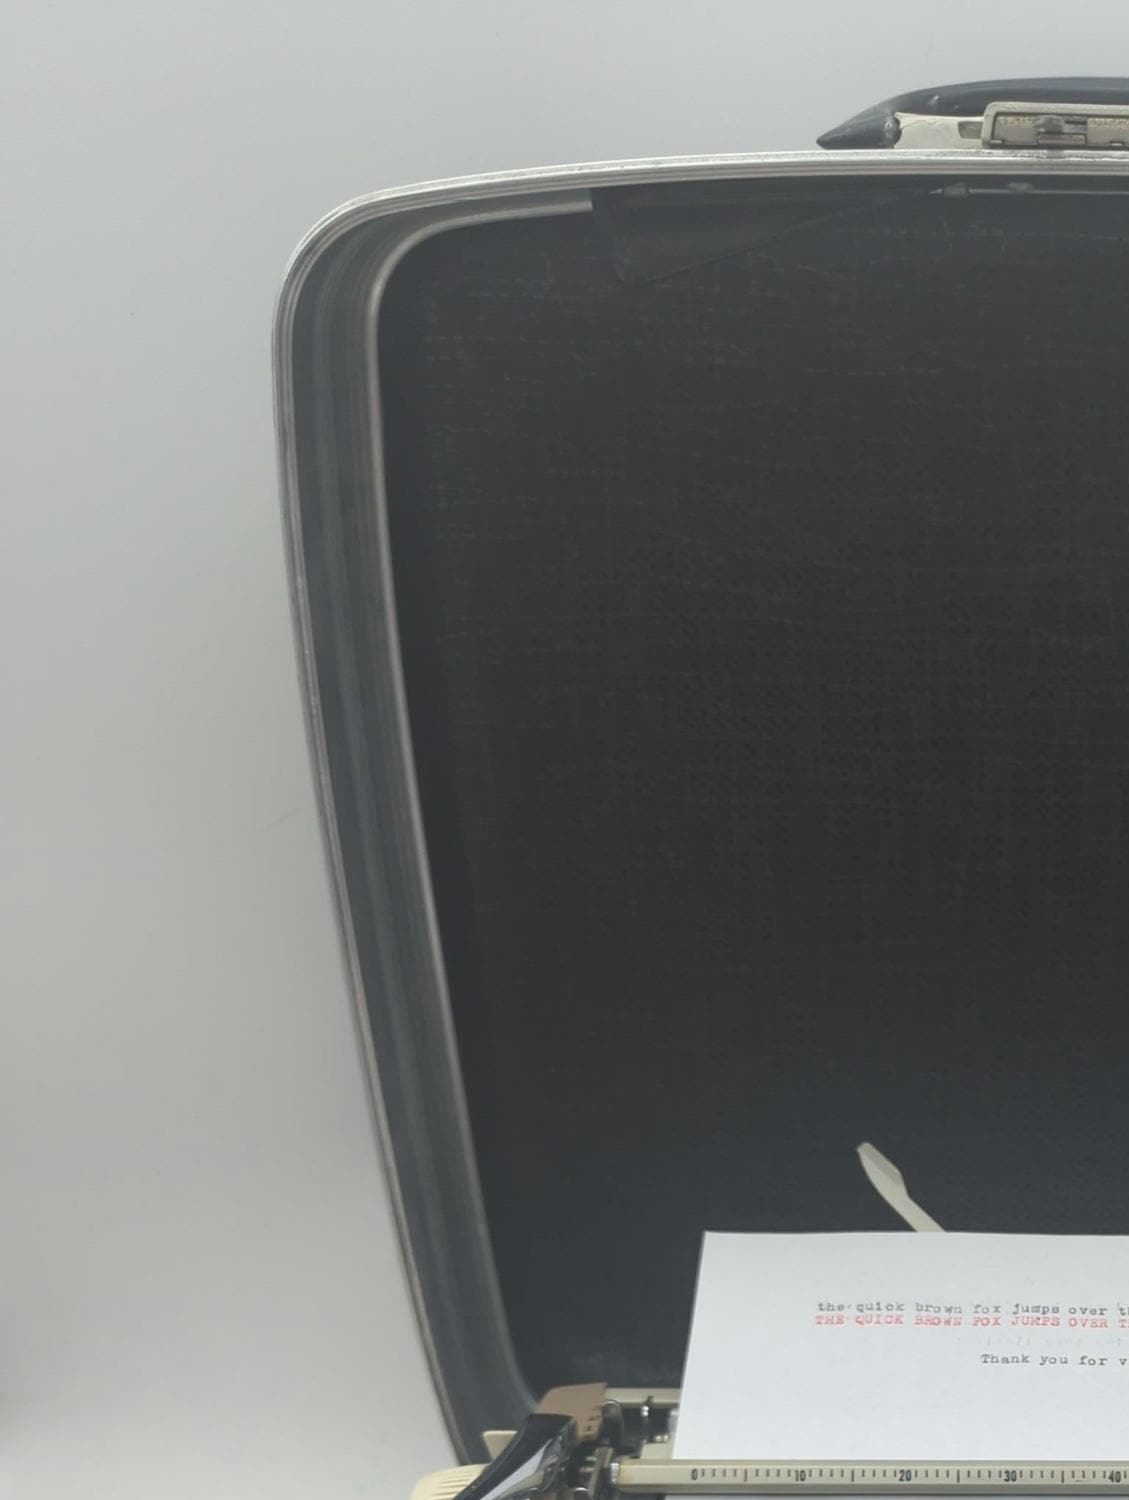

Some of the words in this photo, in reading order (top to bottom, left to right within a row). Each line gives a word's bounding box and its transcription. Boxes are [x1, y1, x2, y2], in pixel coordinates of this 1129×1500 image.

[817, 1302, 845, 1312] the
[855, 1302, 905, 1313] quick
[915, 1302, 963, 1315] brown
[973, 1304, 1001, 1314] fox
[1011, 1303, 1060, 1316] jumps
[1068, 1306, 1108, 1316] over
[816, 1316, 845, 1325] THE
[854, 1316, 904, 1325] QUICK
[914, 1316, 962, 1326] BROWN
[973, 1317, 1001, 1326] FOX
[1011, 1317, 1061, 1327] JUMPS
[1068, 1318, 1108, 1328] OVER
[981, 1353, 1030, 1365] Thank
[1039, 1354, 1069, 1366] you
[1079, 1355, 1108, 1366] for
[691, 1469, 698, 1481] 0
[795, 1469, 806, 1482] 10
[899, 1470, 912, 1482] 20
[1004, 1470, 1017, 1483] 30
[1108, 1470, 1121, 1483] 40
